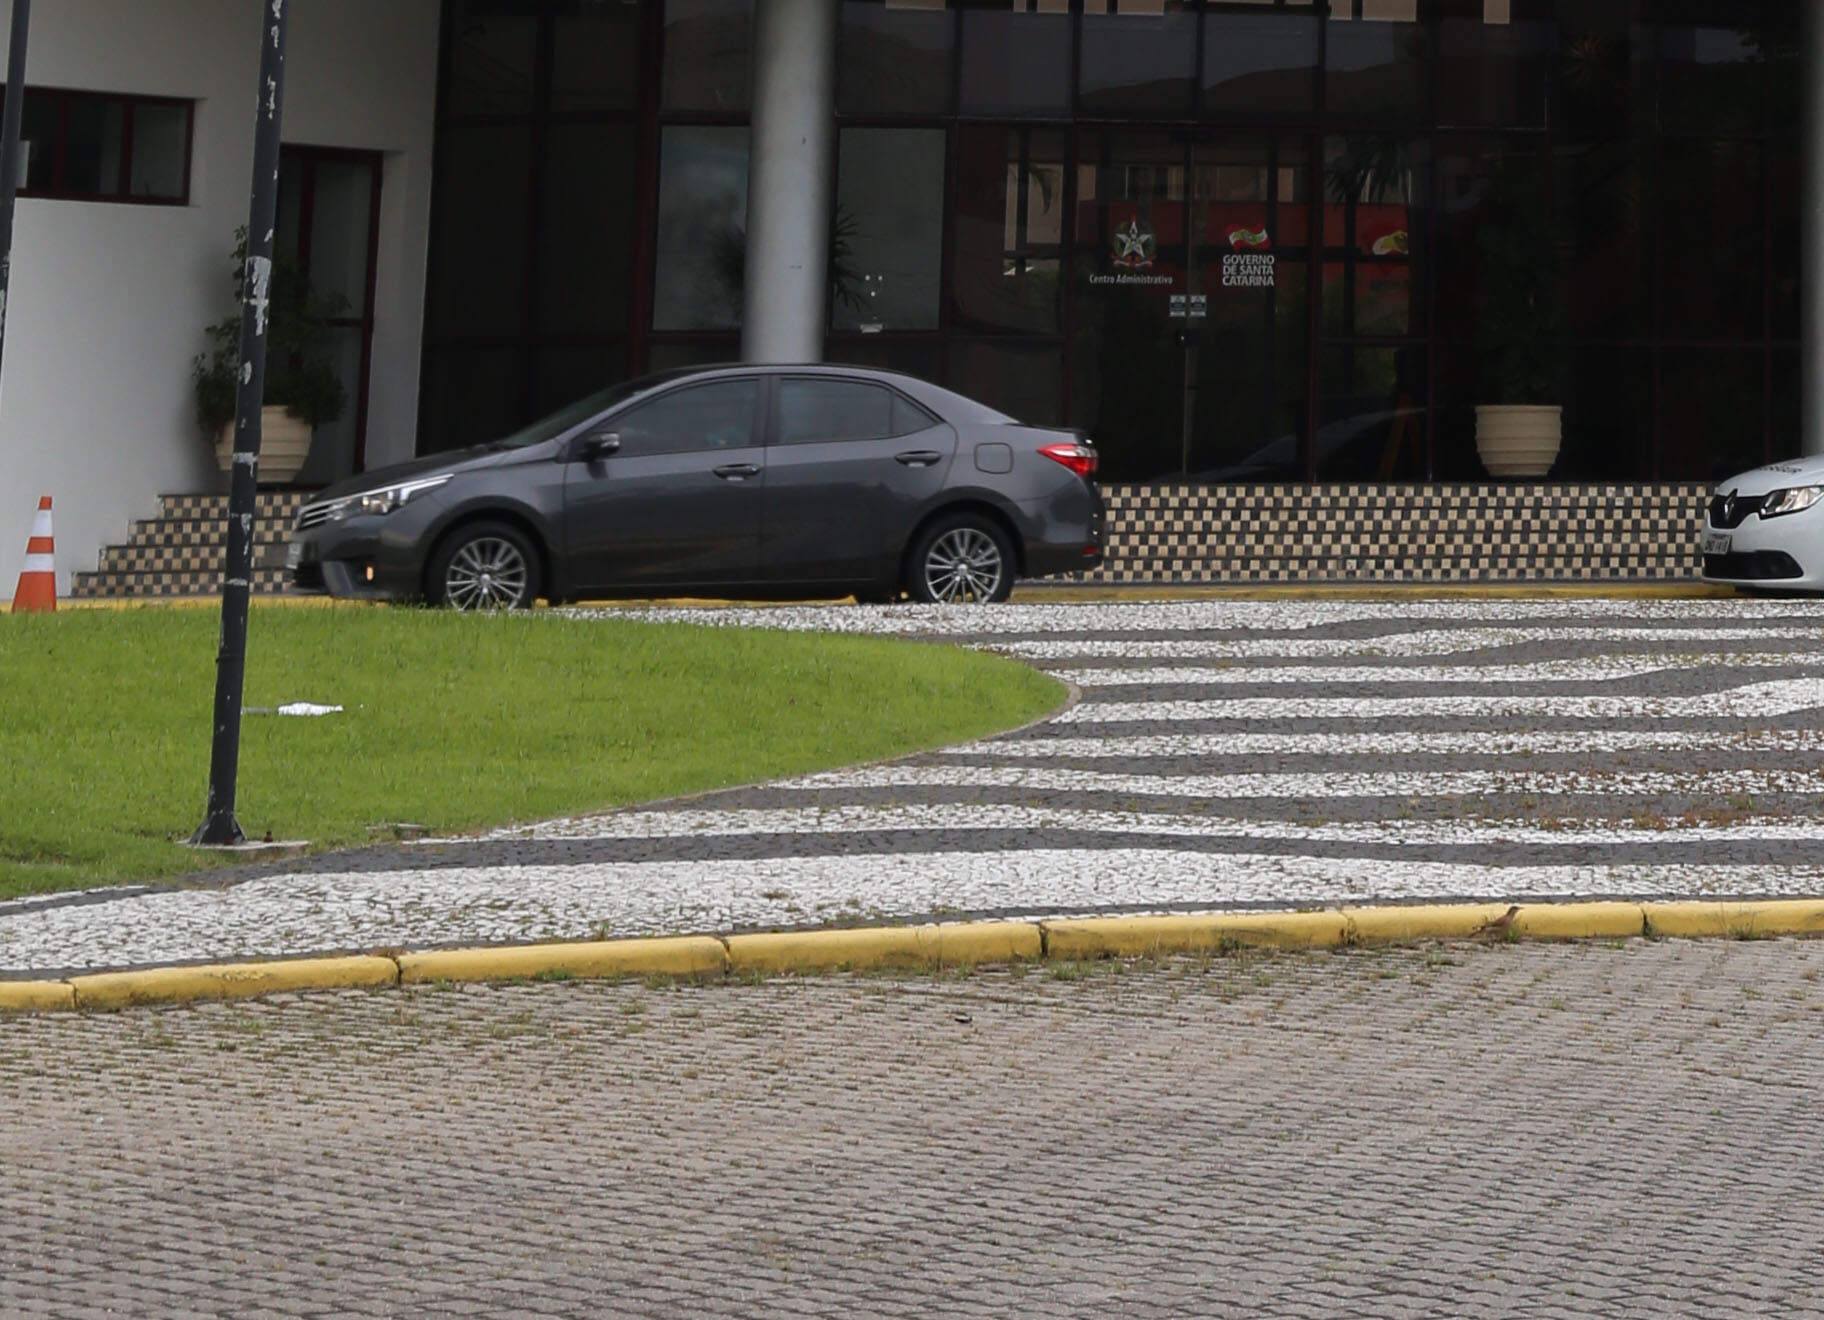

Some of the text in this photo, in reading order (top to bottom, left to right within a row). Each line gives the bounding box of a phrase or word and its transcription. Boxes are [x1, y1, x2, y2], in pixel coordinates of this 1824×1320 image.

[1222, 254, 1275, 266] GOVERNO
[1222, 265, 1275, 276] DE SANTA
[1116, 274, 1173, 285] Administrativo
[1222, 276, 1275, 286] CATARINA
